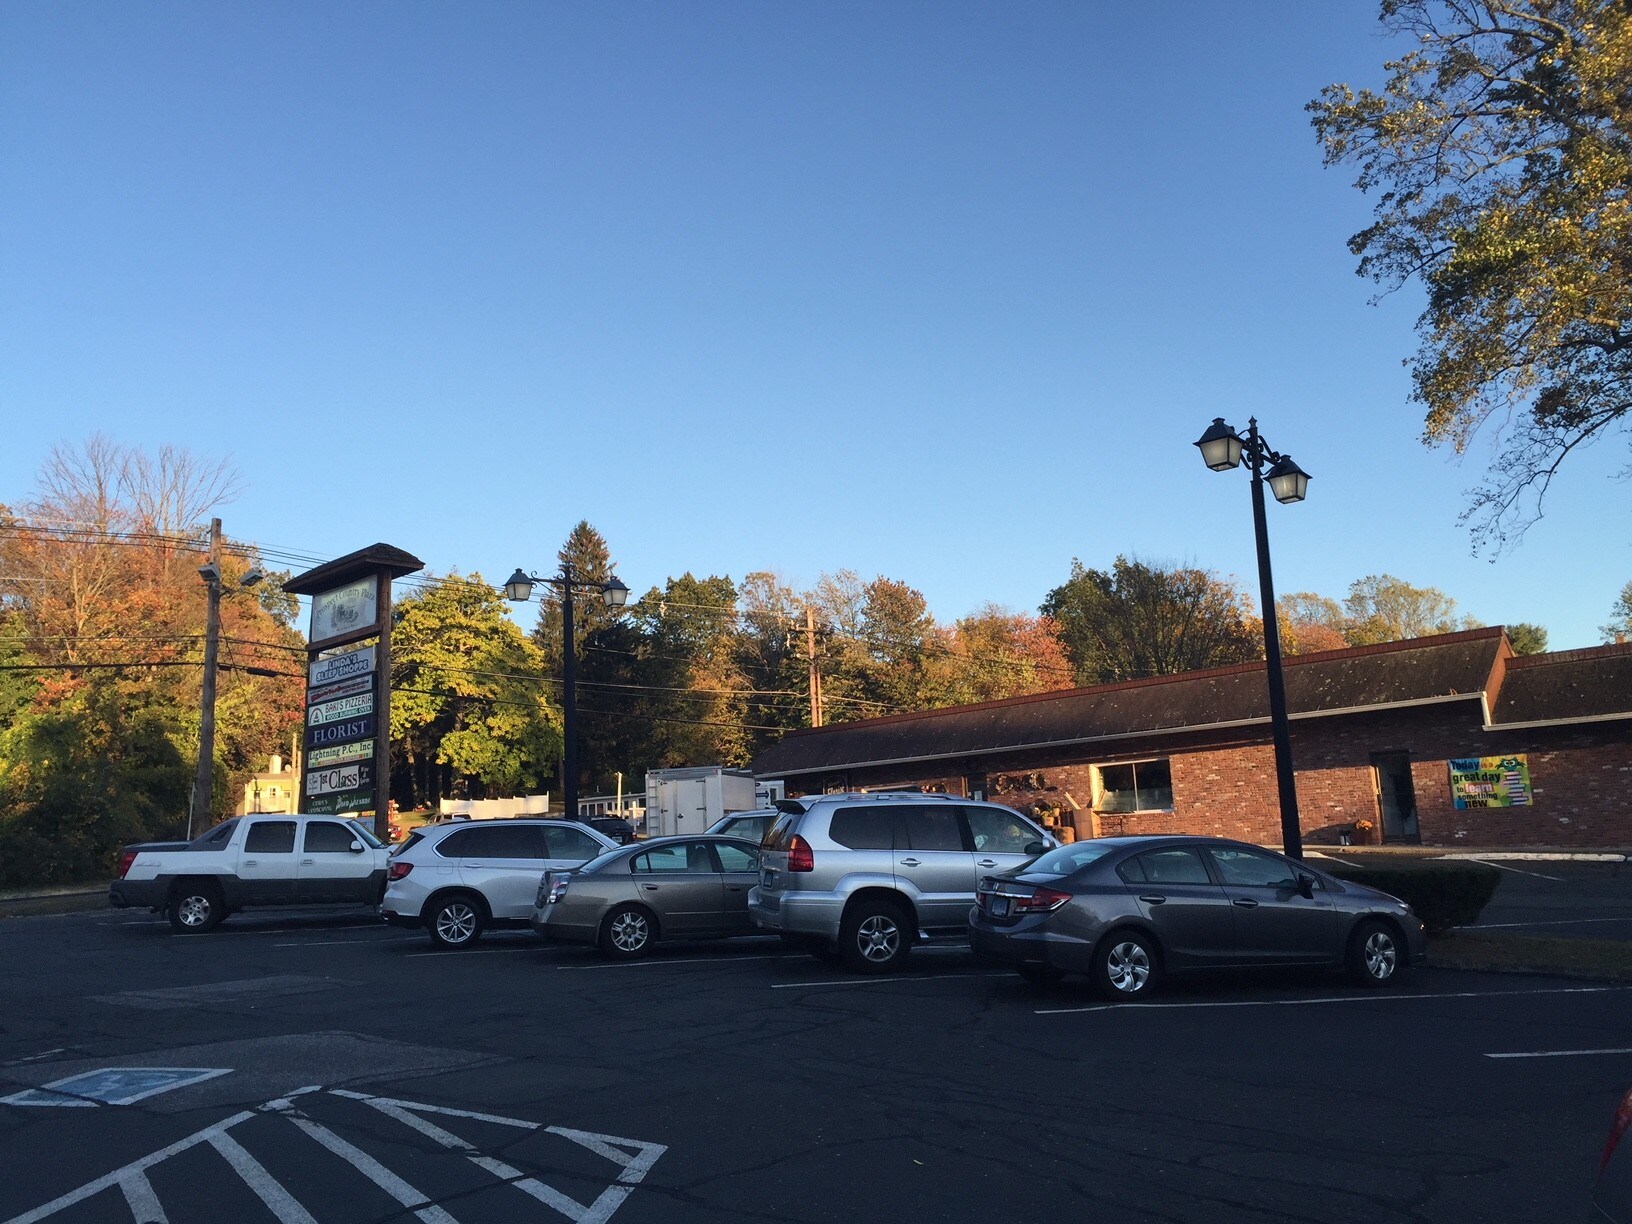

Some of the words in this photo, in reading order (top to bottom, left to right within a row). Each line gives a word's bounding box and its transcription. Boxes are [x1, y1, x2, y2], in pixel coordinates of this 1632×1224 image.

[339, 588, 360, 600] Country
[361, 588, 375, 601] Plaza
[328, 654, 358, 670] LINDA'S
[316, 668, 337, 682] SLEEP
[337, 659, 369, 676] SHOPPE
[345, 694, 372, 710] PIZZERIA
[313, 720, 367, 743] FLORIST
[309, 748, 340, 761] Lightning
[360, 742, 373, 752] Inc.
[1450, 760, 1479, 770] Today
[319, 773, 328, 791] 1st
[329, 769, 358, 790] Class
[1453, 772, 1480, 784] great
[1482, 772, 1500, 782] day
[1465, 783, 1493, 793] learn
[1458, 792, 1498, 800] something
[1465, 799, 1488, 808] new
